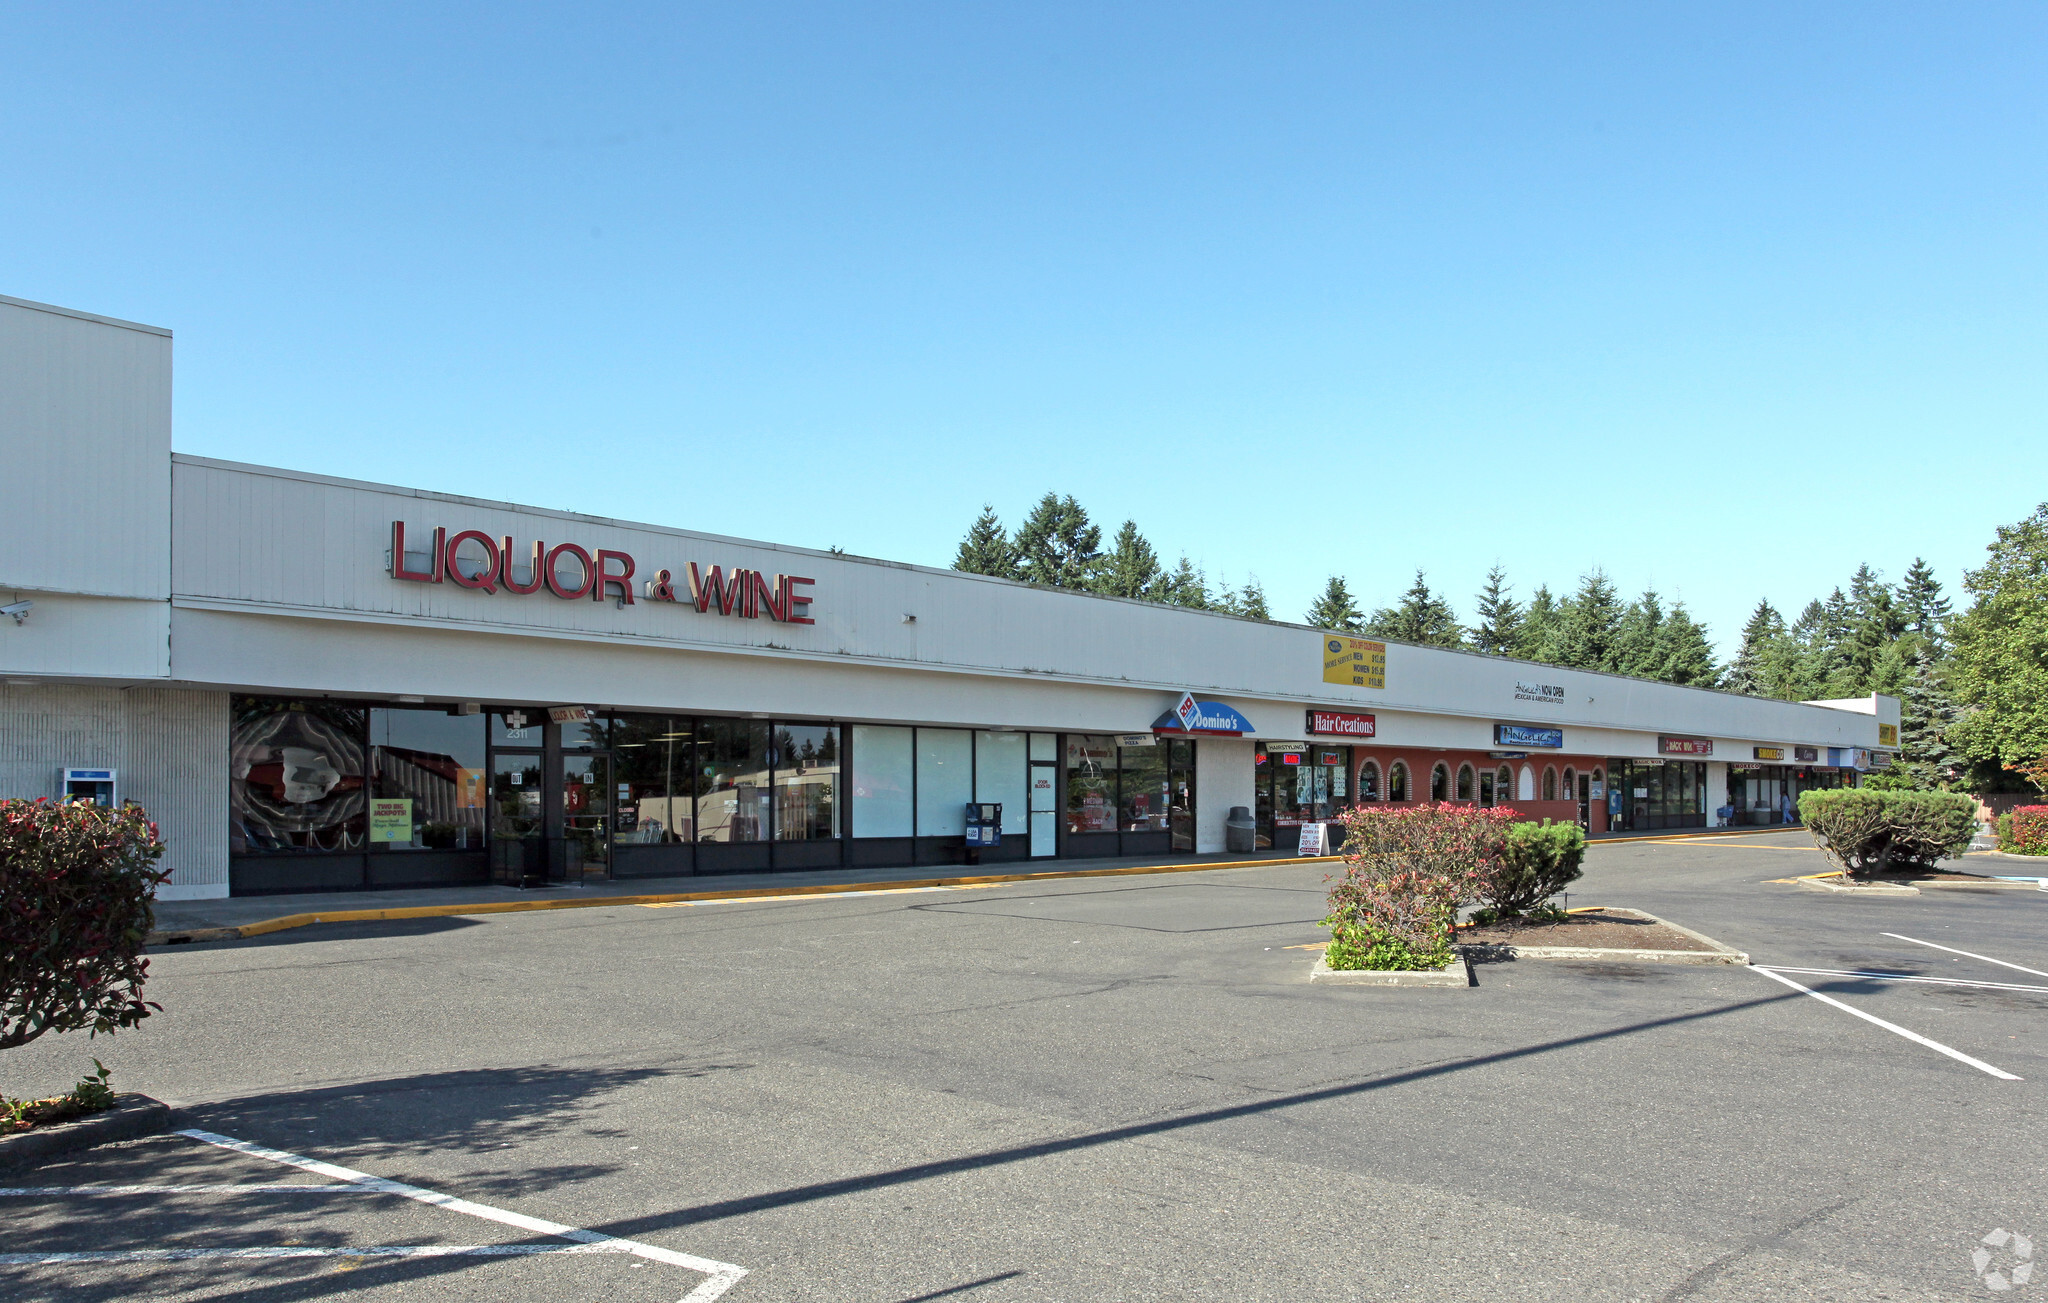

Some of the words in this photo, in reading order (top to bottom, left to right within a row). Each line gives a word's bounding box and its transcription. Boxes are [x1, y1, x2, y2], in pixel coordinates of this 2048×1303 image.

[391, 520, 635, 606] LIQUOR
[650, 569, 676, 602] &
[685, 561, 816, 626] WINE
[1353, 652, 1363, 660] MEN
[1353, 664, 1370, 673] WOMEN
[1353, 676, 1364, 685] KIDS
[1542, 685, 1552, 696] NOW
[1553, 686, 1564, 697] OPEN
[553, 710, 568, 721] LIQUOR
[570, 711, 575, 720] &
[576, 708, 588, 720] WINE
[1196, 713, 1238, 730] Domino's
[1315, 715, 1334, 731] Hair
[1335, 716, 1374, 734] Creations
[507, 728, 528, 739] 2311
[512, 774, 521, 784] OUT
[585, 774, 592, 783] IN
